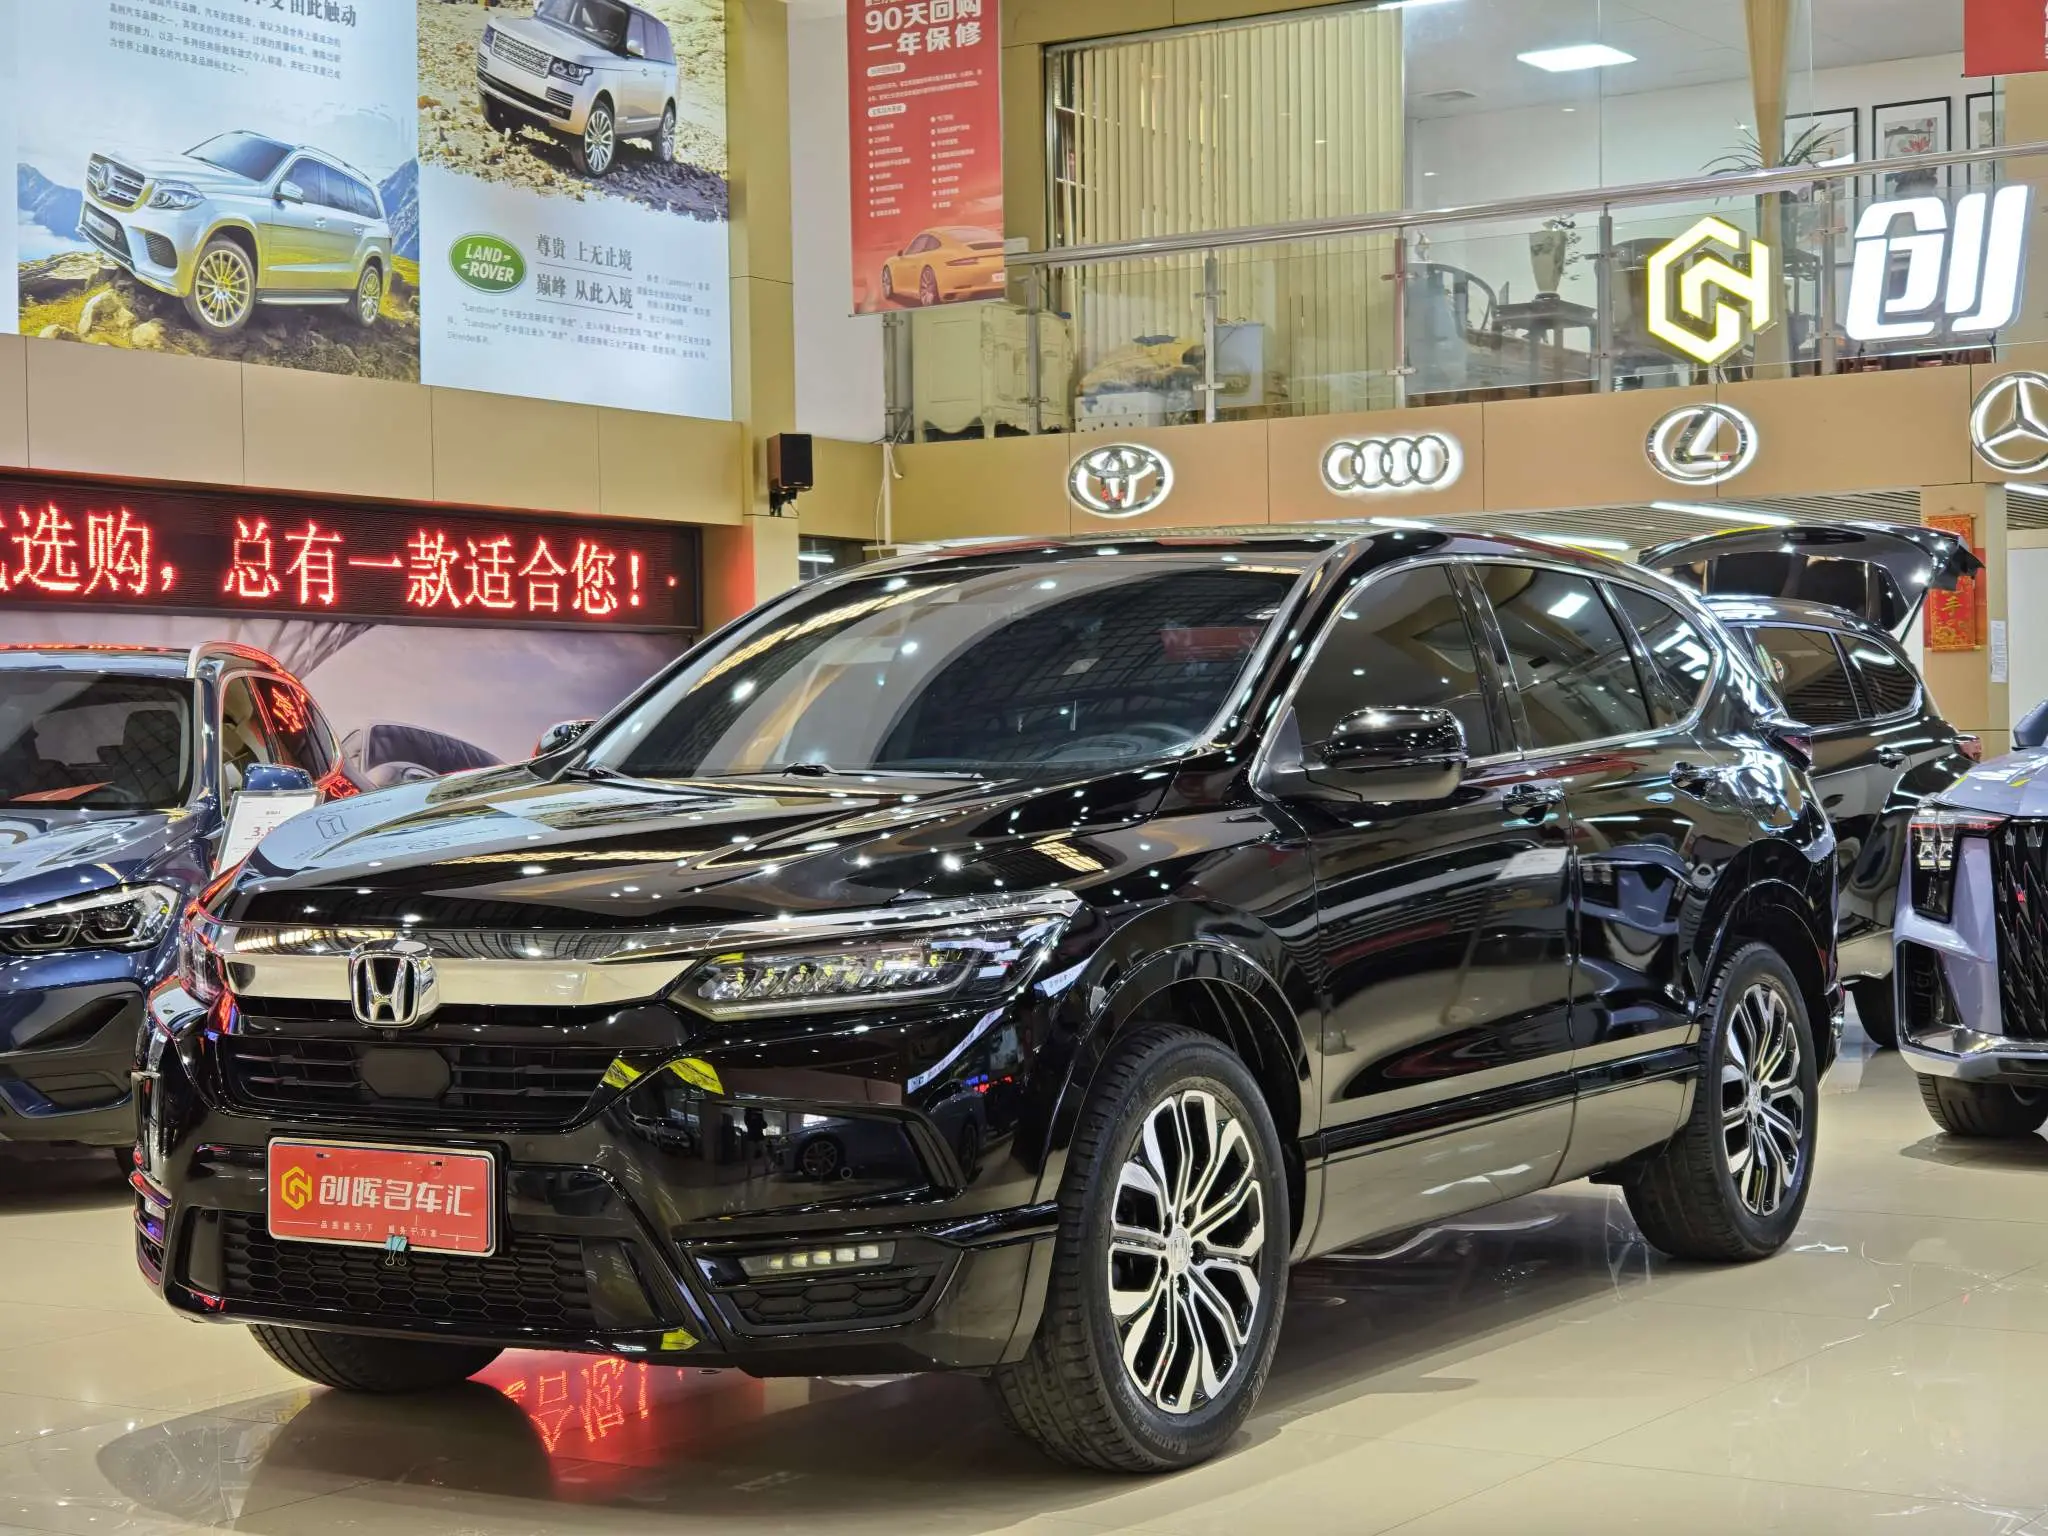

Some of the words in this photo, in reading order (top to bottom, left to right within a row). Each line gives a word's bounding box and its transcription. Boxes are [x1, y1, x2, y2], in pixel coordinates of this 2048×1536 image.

[867, 21, 982, 56] 一年保修
[465, 243, 503, 263] LAND
[536, 233, 566, 260] 尊贵
[574, 240, 633, 271] 上无止境
[468, 261, 515, 282] ROVER
[536, 273, 567, 298] 巅峰
[576, 279, 634, 309] 从此入境
[319, 1175, 475, 1217] 创晖名车汇
